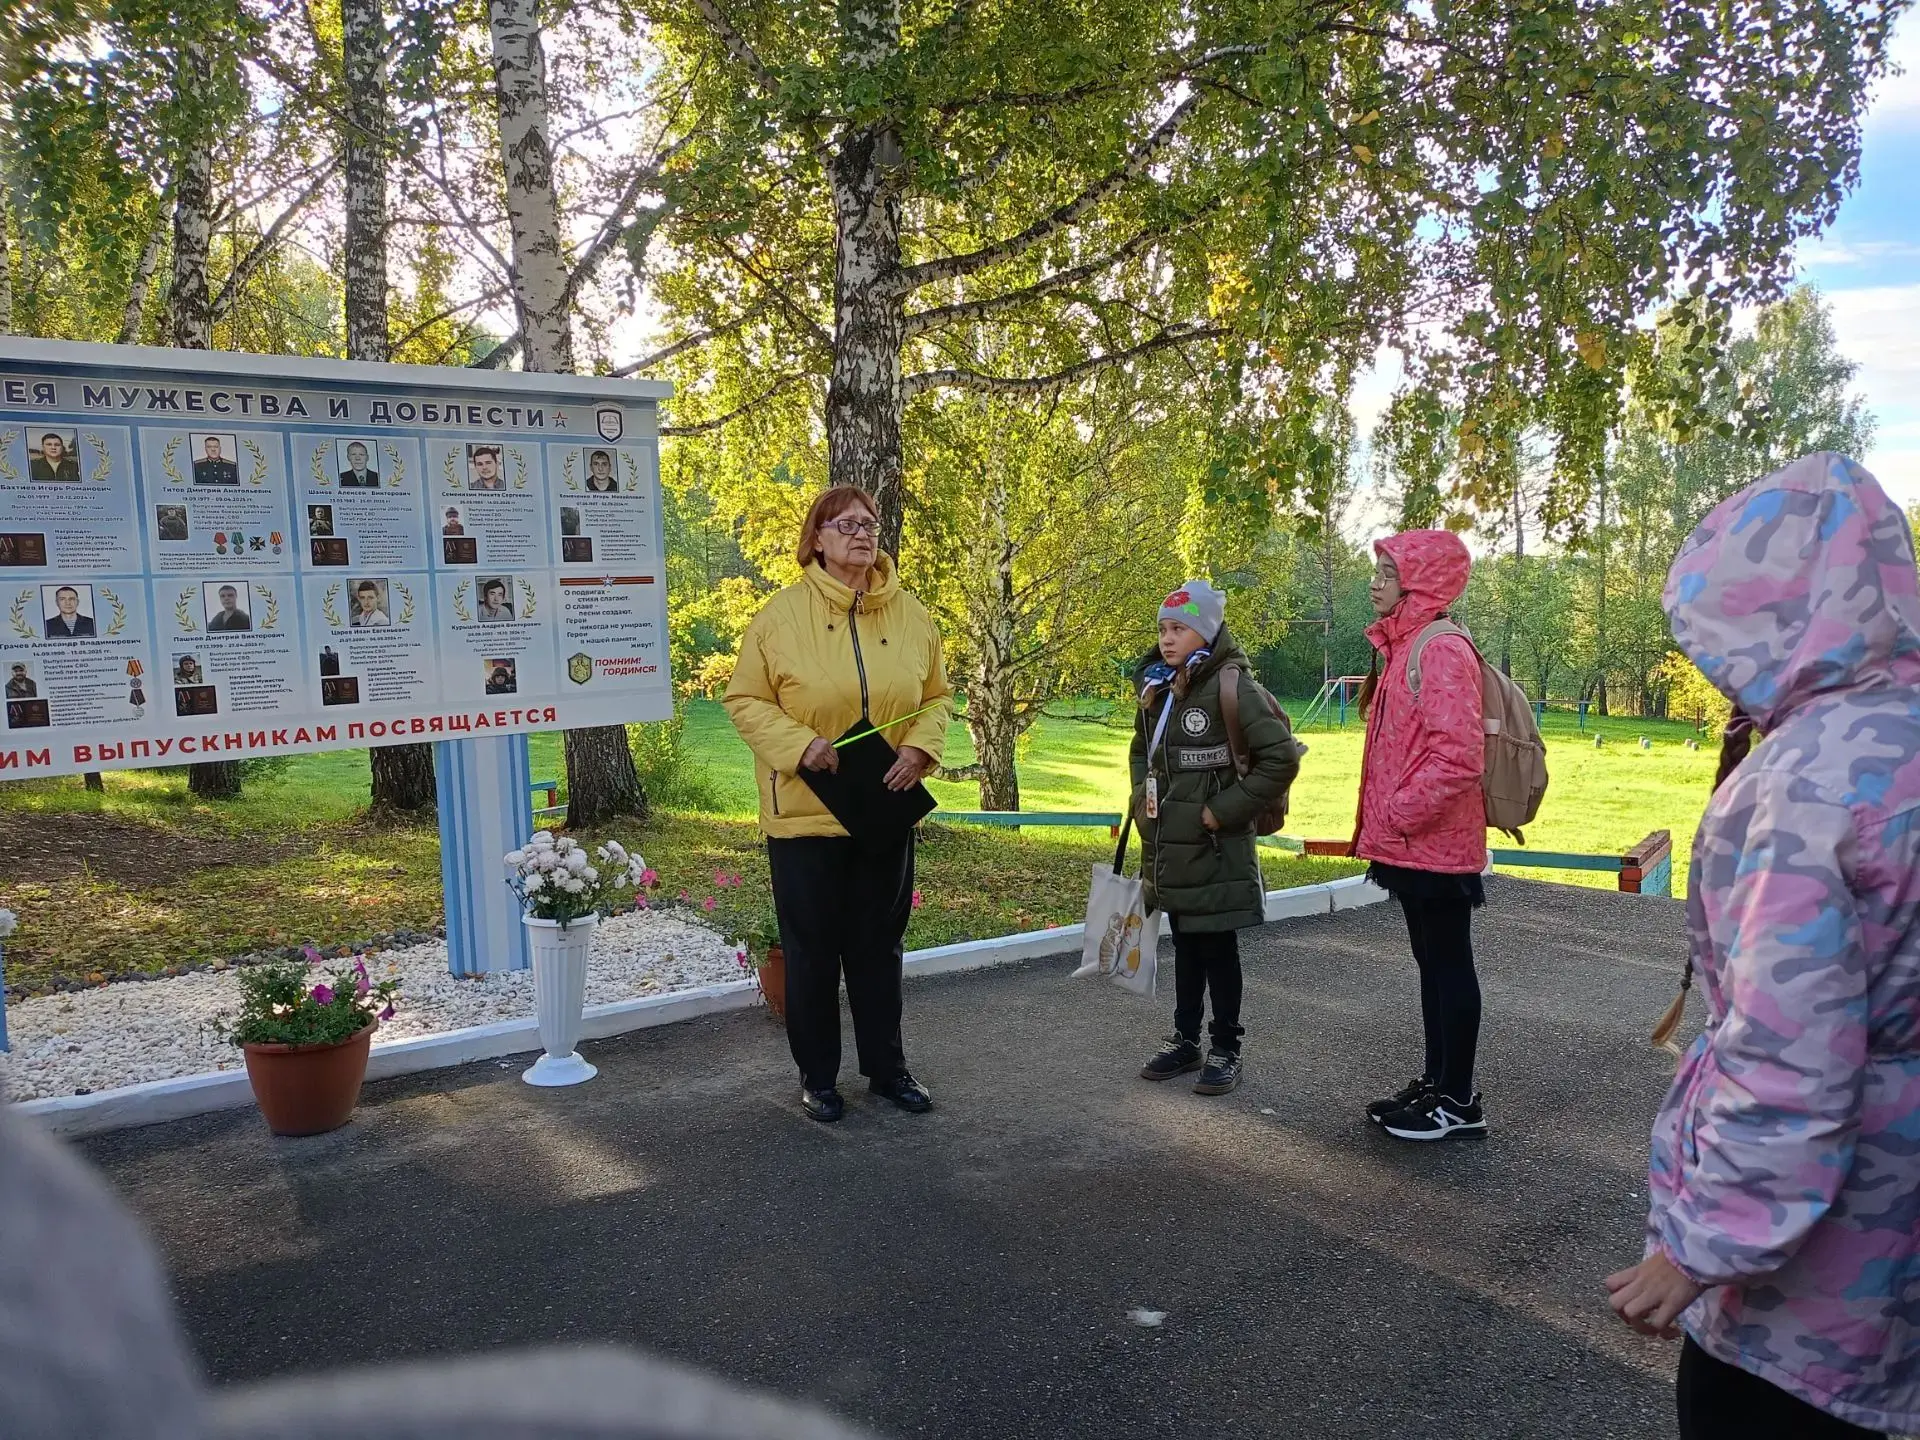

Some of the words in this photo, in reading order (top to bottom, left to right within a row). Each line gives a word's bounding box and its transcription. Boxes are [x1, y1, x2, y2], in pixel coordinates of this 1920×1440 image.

[83, 385, 310, 419] МУЖЕСТВА
[329, 398, 350, 419] И
[369, 400, 545, 428] ДОБЛЕСТИ
[579, 623, 609, 631] никогда
[567, 631, 588, 639] Герои
[586, 636, 610, 644] нашей
[31, 641, 78, 649] Александр
[595, 656, 642, 667] ПОМНИМ!
[603, 665, 657, 677] ГОРДИМСЯ!
[74, 725, 336, 764] ВЫПУСКНИКАМ
[348, 707, 557, 740] ПОСВЯЩАЕТСЯ
